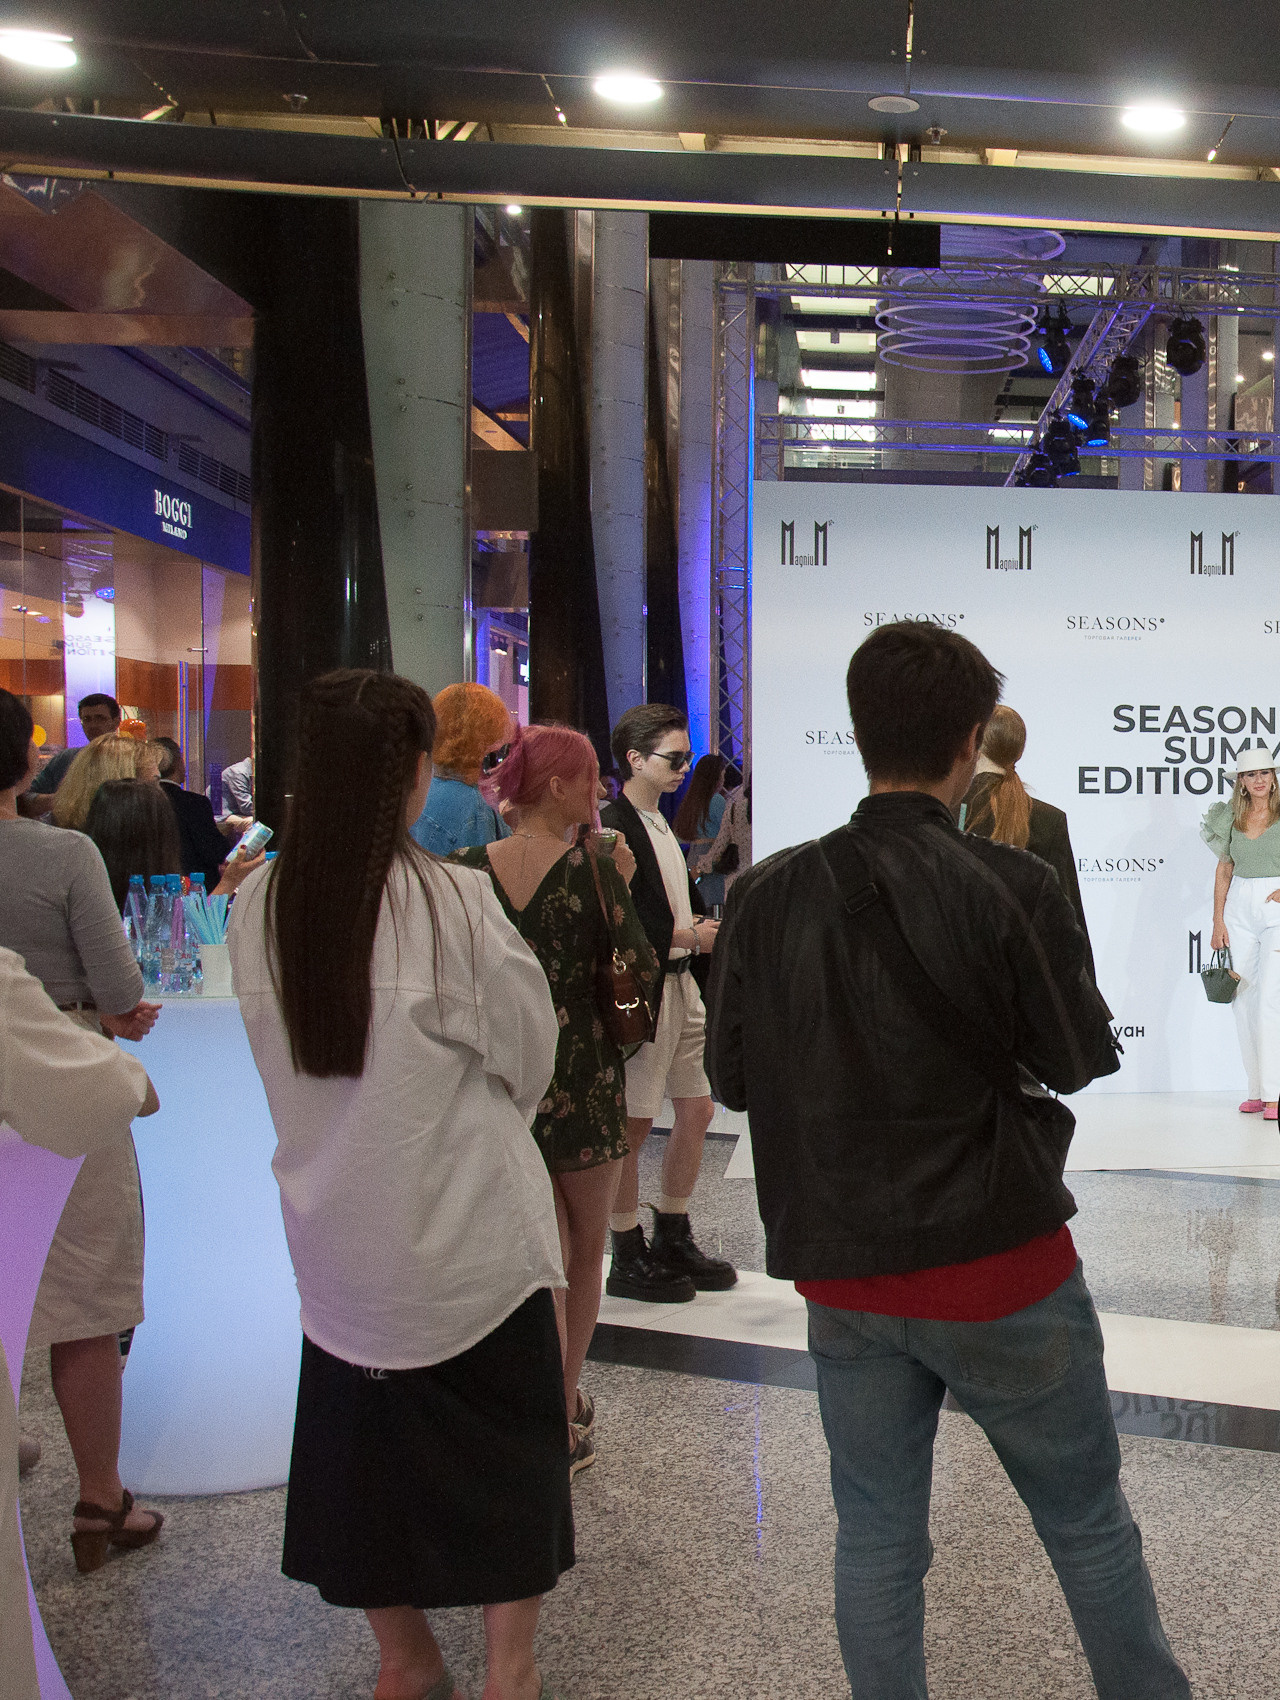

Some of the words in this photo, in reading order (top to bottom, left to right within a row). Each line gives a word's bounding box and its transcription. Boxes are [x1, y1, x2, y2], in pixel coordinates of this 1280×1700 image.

[154, 489, 193, 528] BOGGI
[162, 521, 188, 540] MILANO
[805, 730, 855, 745] SEAS
[1078, 858, 1157, 873] EASONS
[1113, 1025, 1145, 1040] уан
